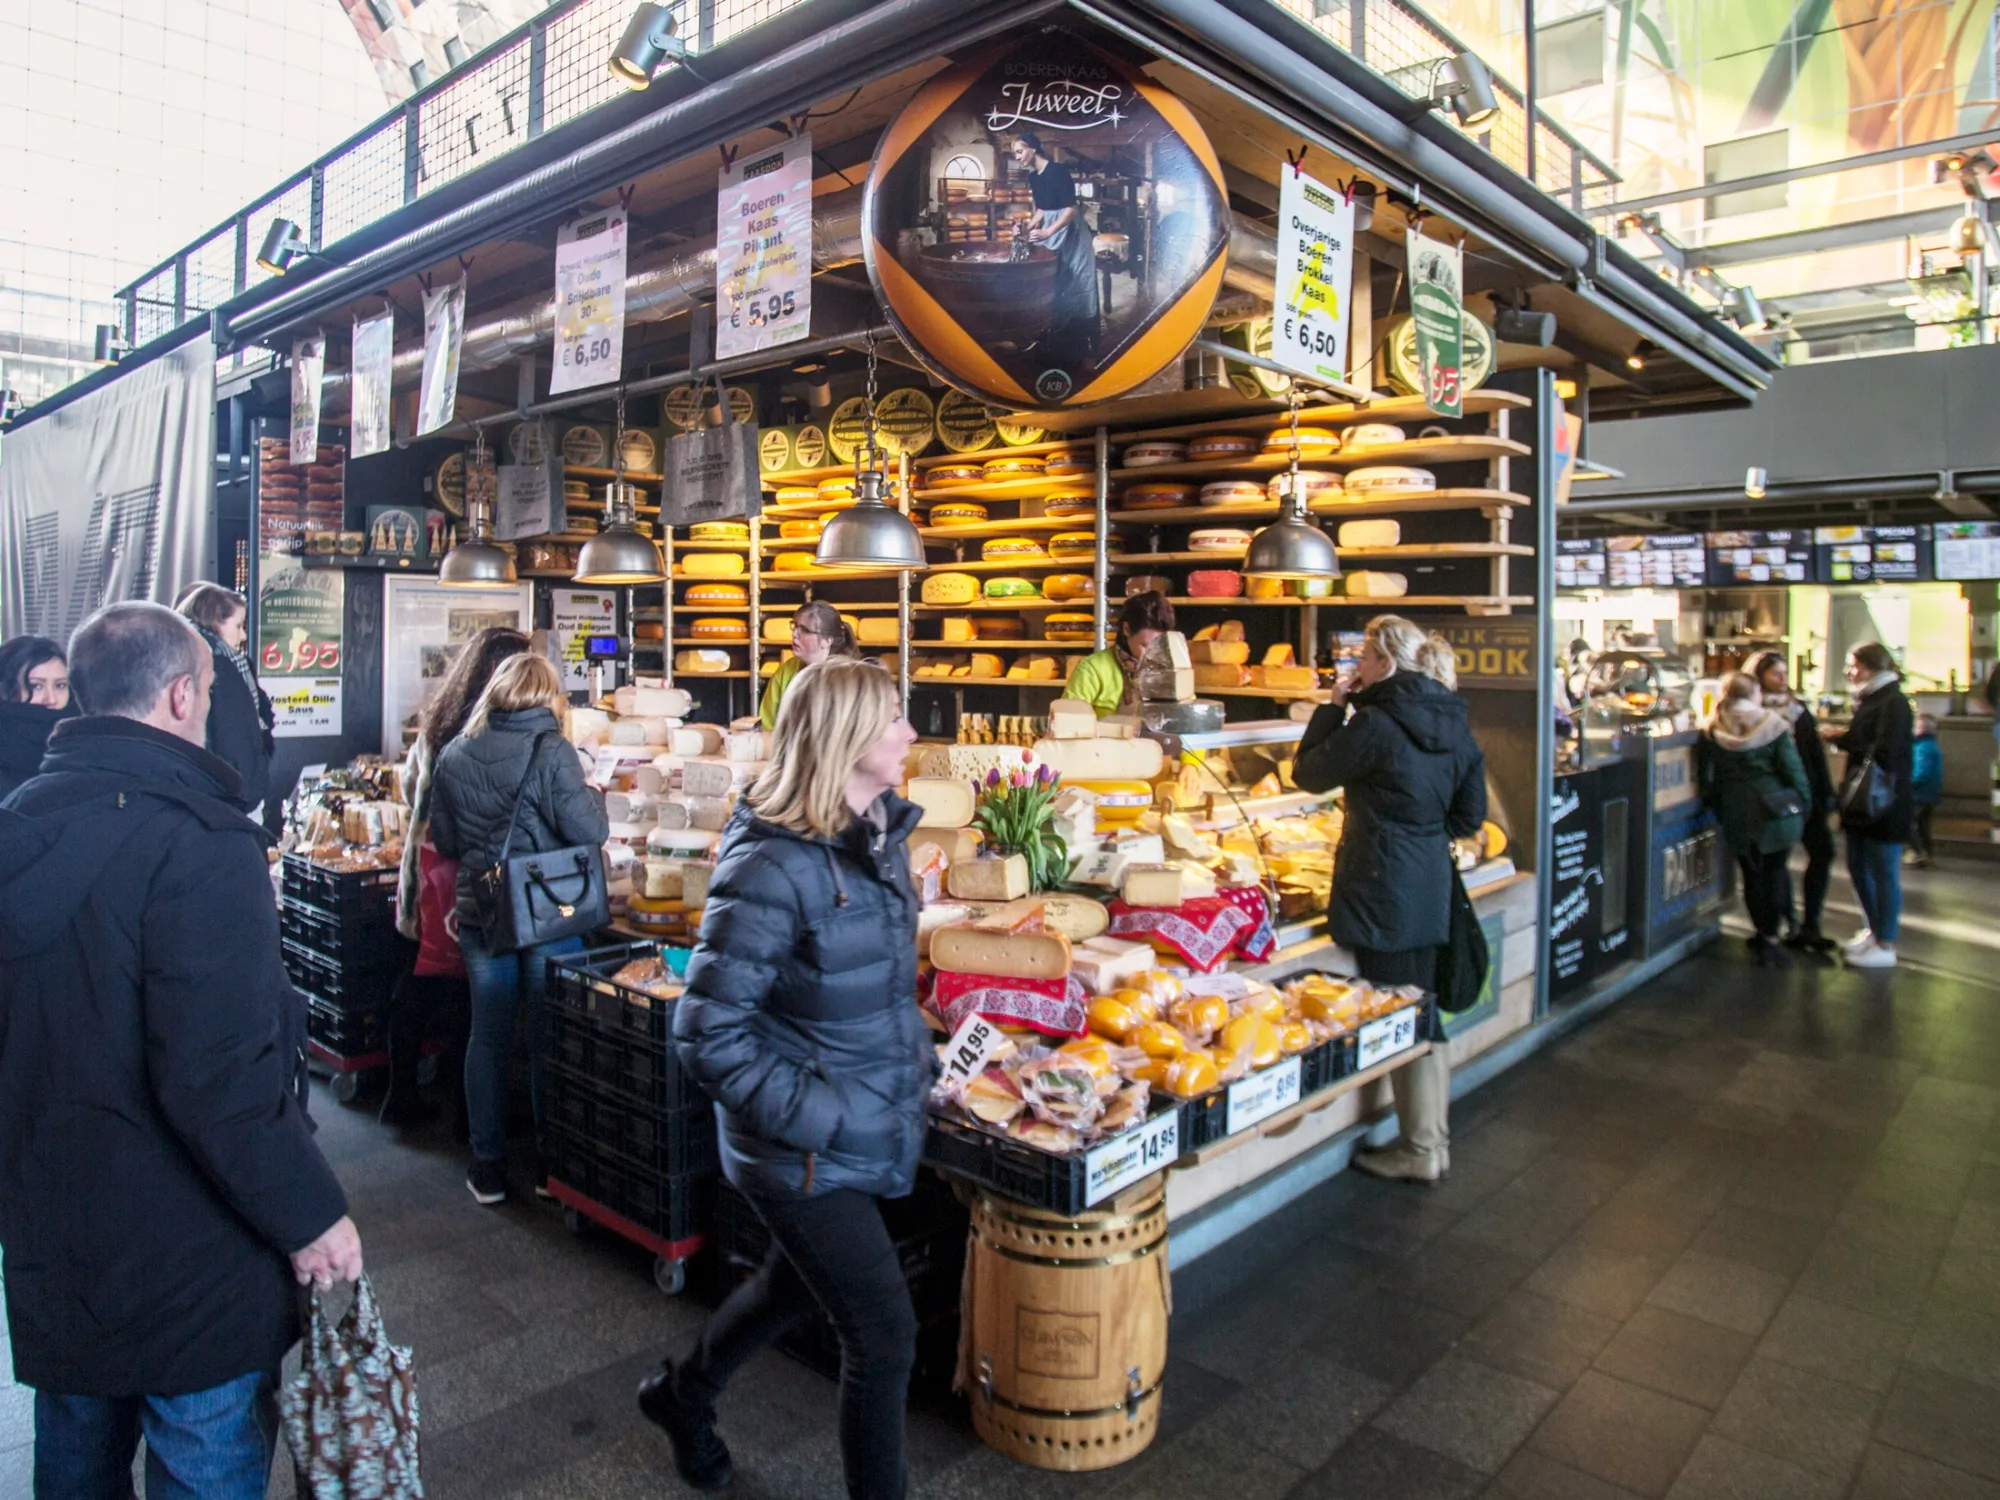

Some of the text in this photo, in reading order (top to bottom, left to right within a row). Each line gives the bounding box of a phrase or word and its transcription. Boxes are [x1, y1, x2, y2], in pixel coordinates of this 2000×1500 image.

[1004, 62, 1108, 79] BOERENKAAS
[988, 80, 1121, 131] Juweel
[741, 193, 784, 216] Boeren
[748, 215, 778, 235] Kaas
[1292, 215, 1341, 251] Overjarige
[743, 231, 783, 256] Pikant
[1299, 239, 1333, 266] Boeren
[578, 270, 601, 285] Oude
[1297, 258, 1333, 285] Brokkel
[1302, 281, 1326, 303] Kaas
[731, 291, 795, 328] € 5,95
[1284, 318, 1335, 357] € 6,50
[563, 338, 611, 367] € 6,50
[267, 537, 303, 550] gerijp
[557, 622, 611, 633] Oud Belegen
[261, 640, 340, 673] 6,95
[288, 706, 314, 714] Saus
[312, 695, 336, 704] Dille
